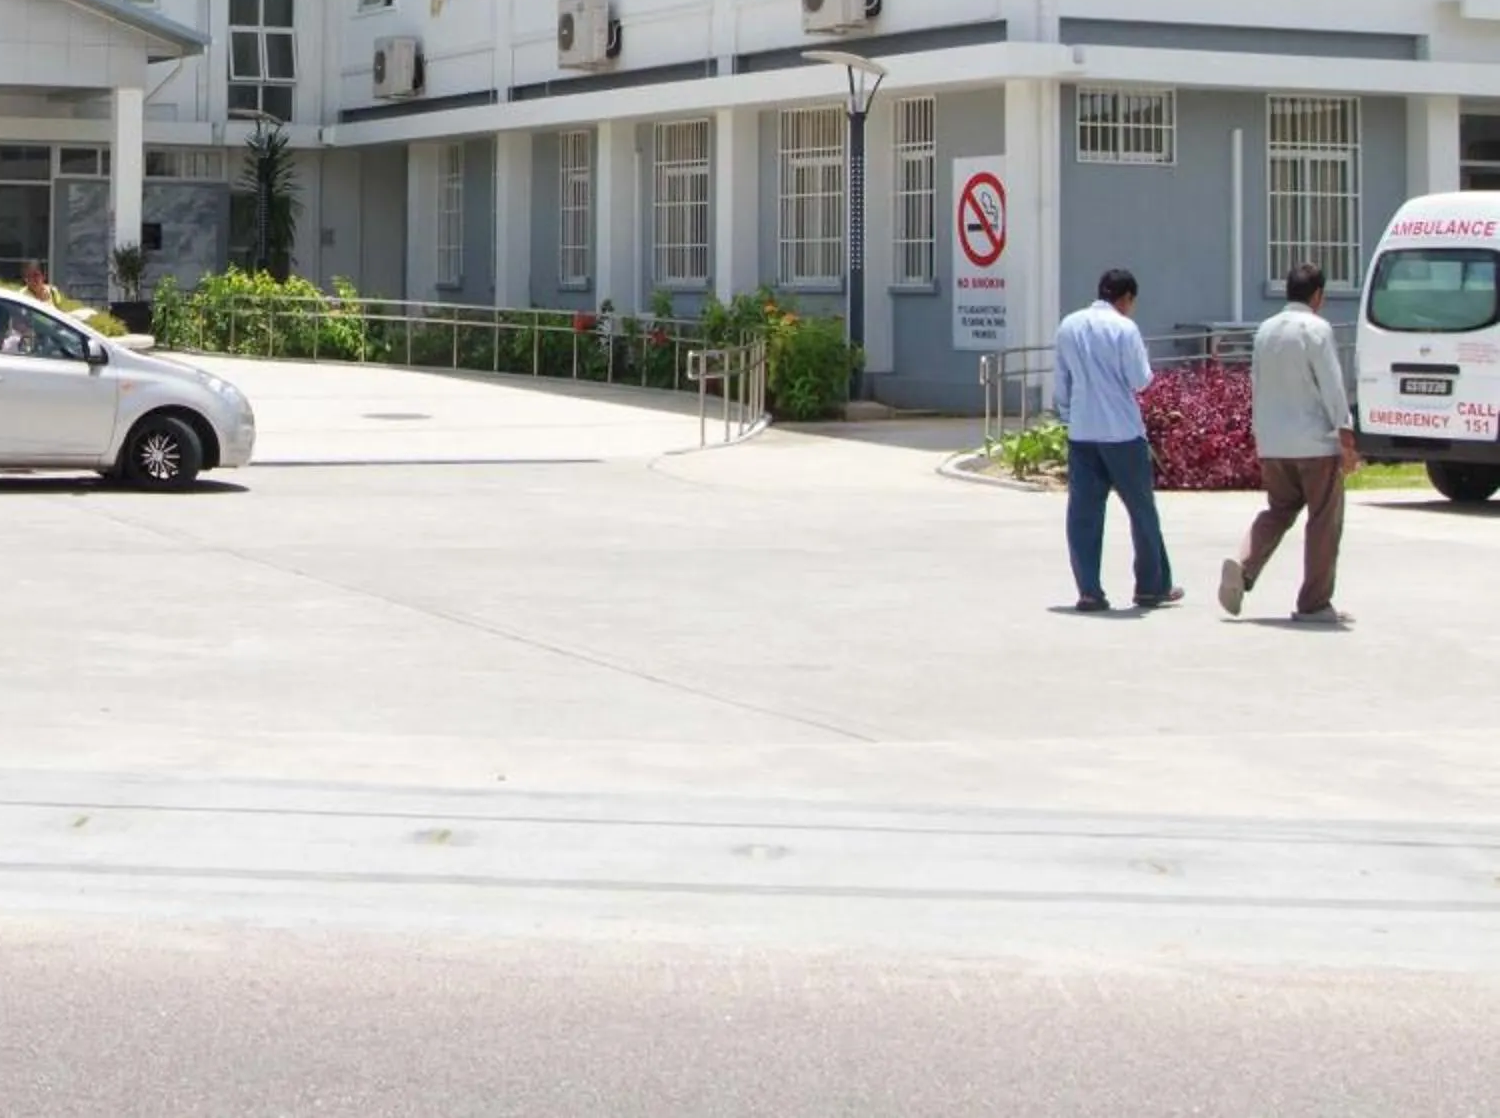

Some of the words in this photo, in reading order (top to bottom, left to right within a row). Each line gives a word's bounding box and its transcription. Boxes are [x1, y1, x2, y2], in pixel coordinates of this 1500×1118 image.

[1391, 220, 1496, 236] AMBULANCE
[971, 277, 1005, 289] SMOKIN
[1456, 402, 1497, 417] CALL
[1369, 410, 1451, 428] EMERGENCY
[1465, 420, 1489, 434] 151
